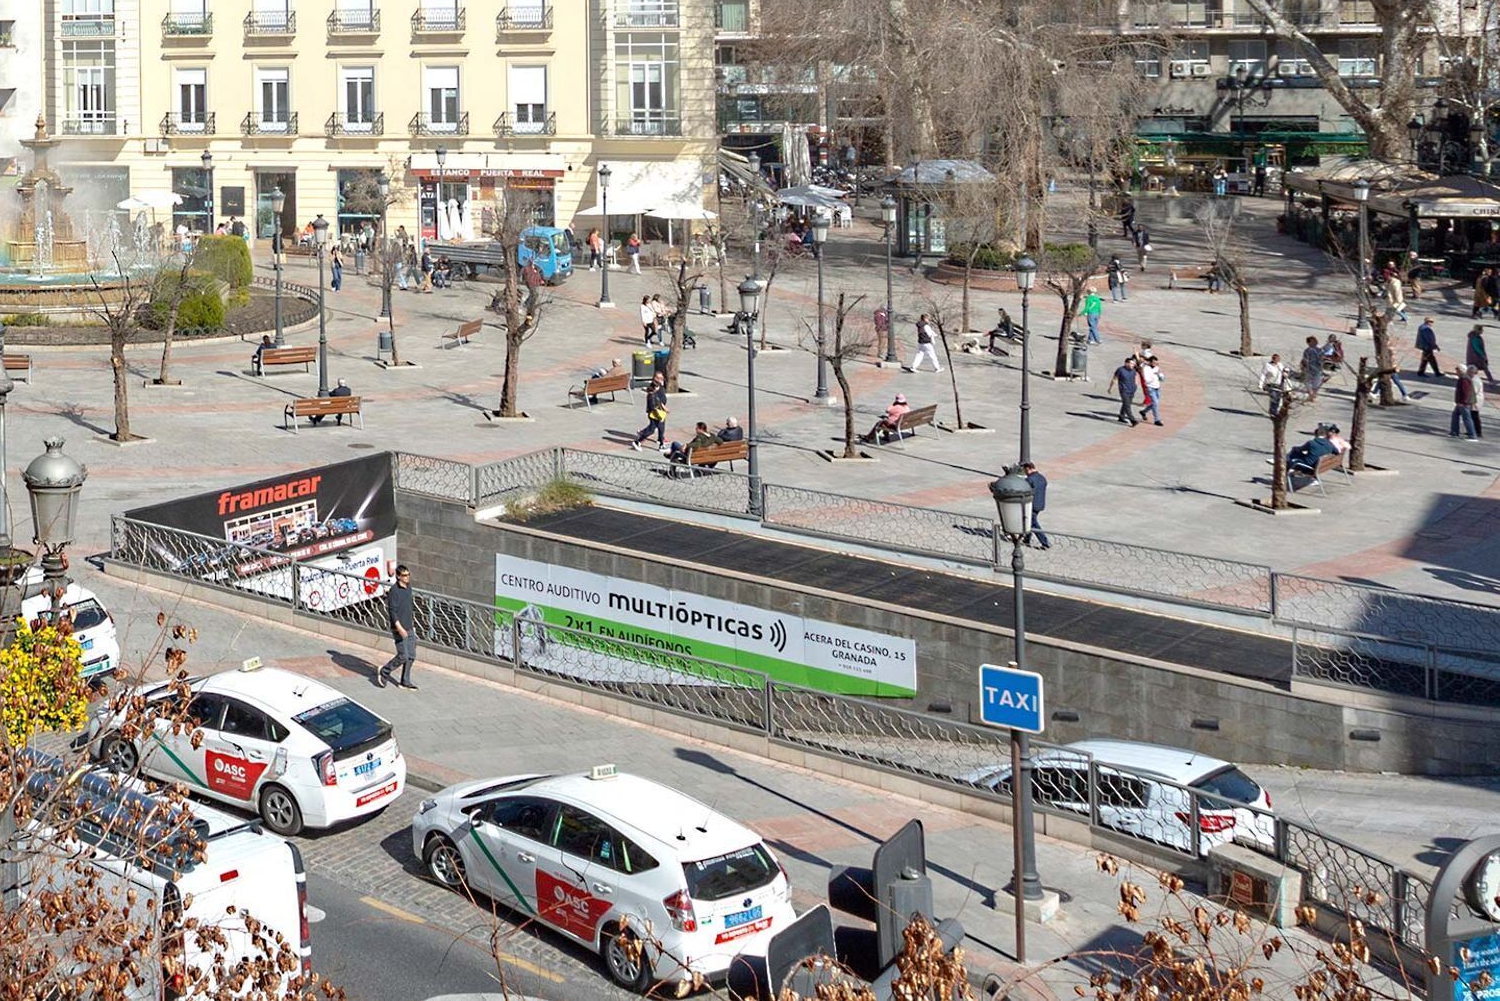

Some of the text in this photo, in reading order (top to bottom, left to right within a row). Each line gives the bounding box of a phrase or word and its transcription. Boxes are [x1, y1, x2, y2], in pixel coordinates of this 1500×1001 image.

[480, 169, 515, 177] PUERTA
[217, 474, 322, 515] framacar
[345, 554, 380, 572] Puerta Real
[501, 573, 544, 593] CENTRO
[546, 583, 601, 605] AUDITIVO
[565, 615, 593, 633] 2x1
[599, 625, 615, 638] EN
[618, 630, 692, 656] AUDÍFONOS
[803, 631, 833, 645] ACERA
[835, 638, 852, 650] DEL
[894, 651, 907, 661] 15
[832, 649, 878, 667] GRANADA
[984, 685, 1038, 713] TAXI
